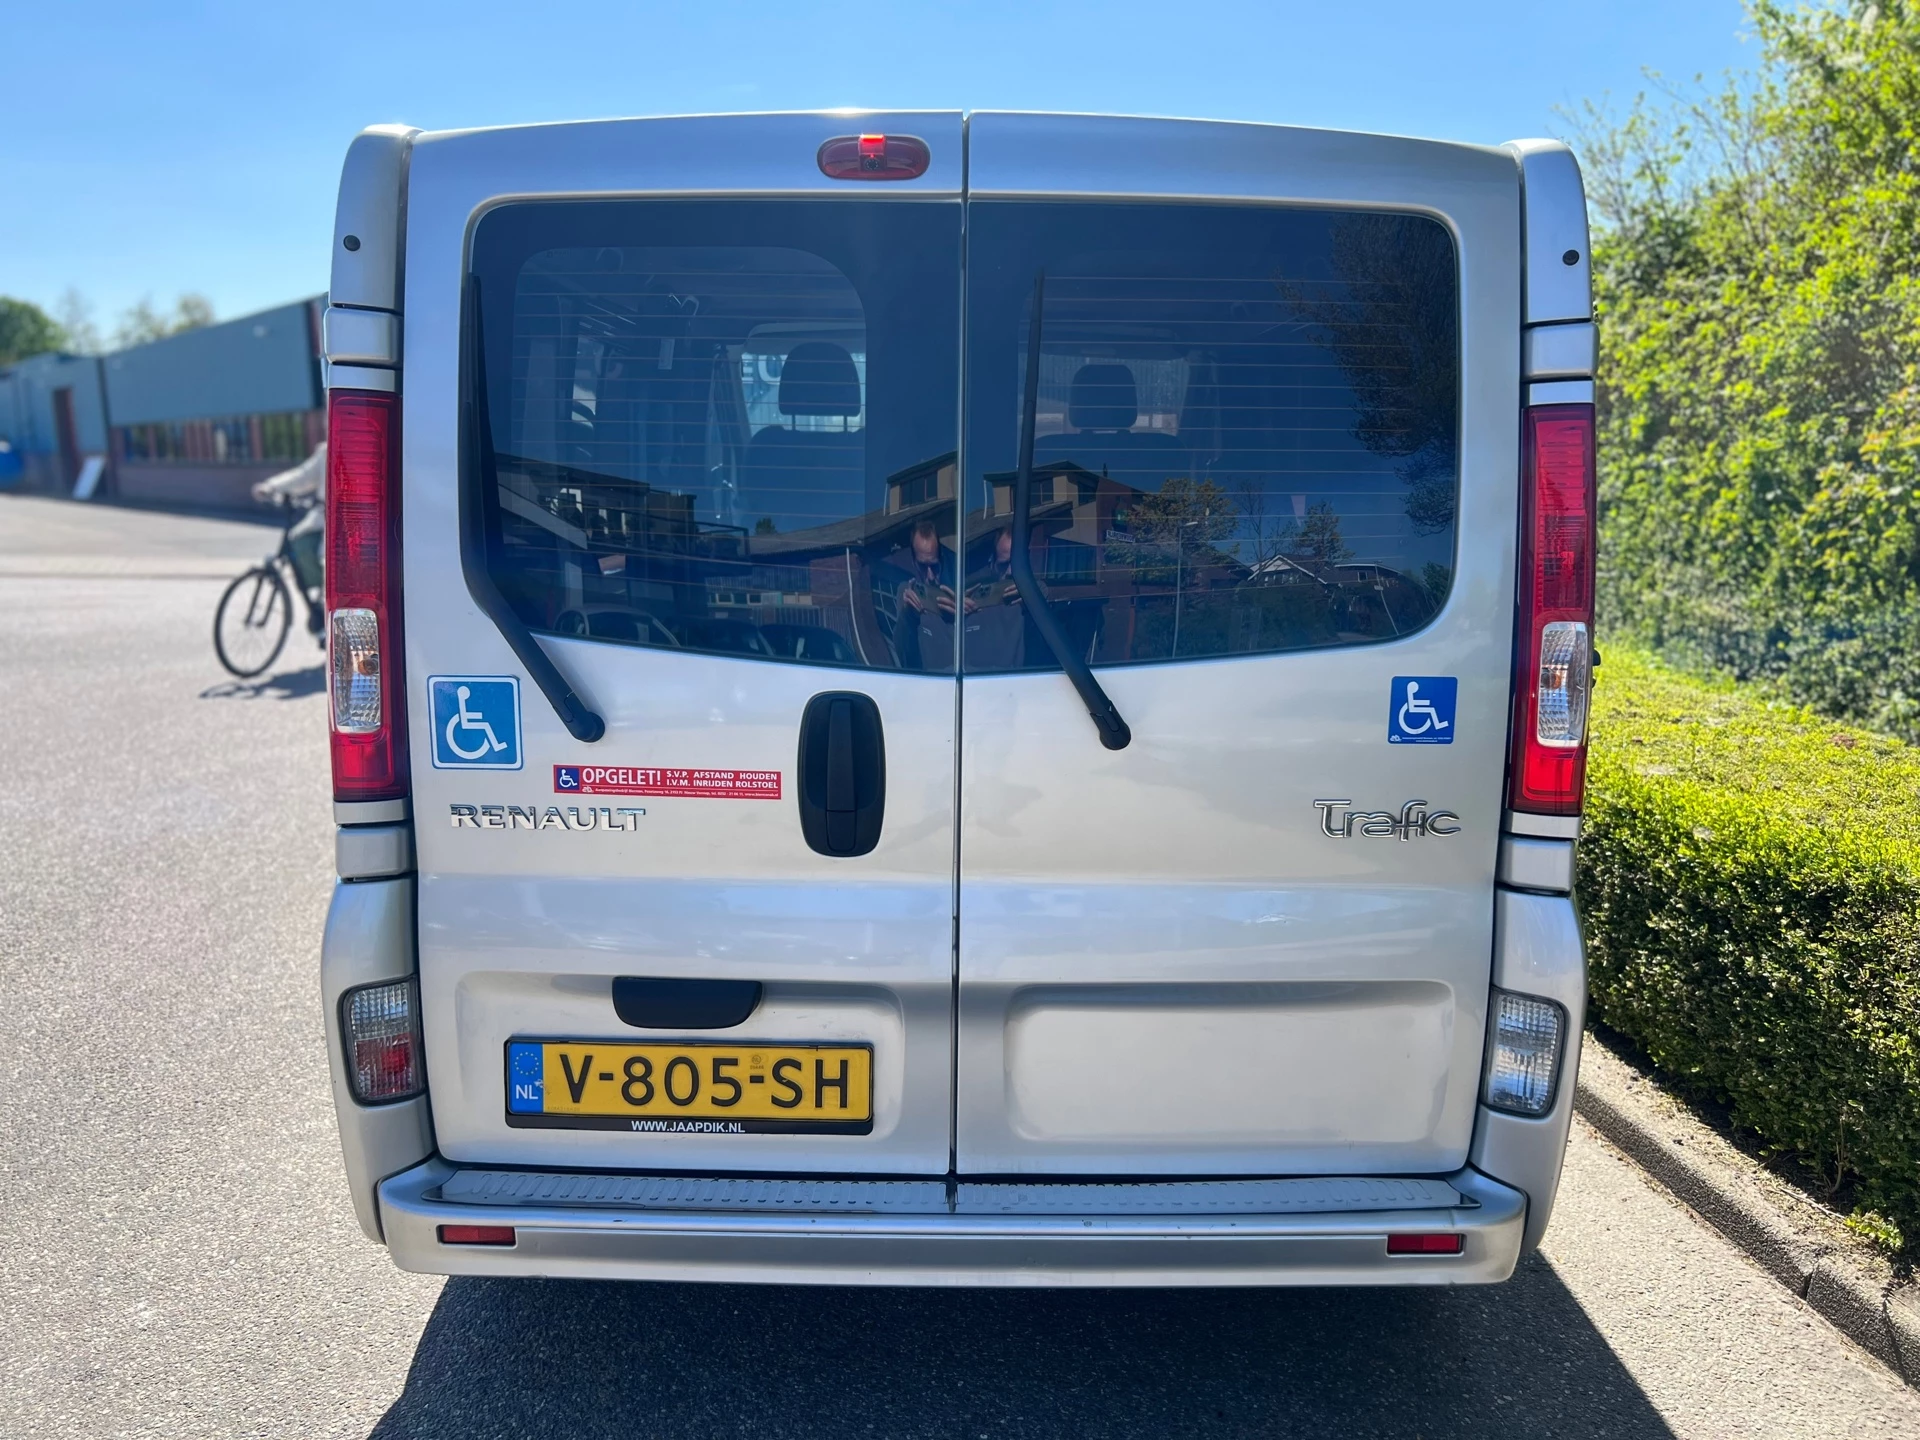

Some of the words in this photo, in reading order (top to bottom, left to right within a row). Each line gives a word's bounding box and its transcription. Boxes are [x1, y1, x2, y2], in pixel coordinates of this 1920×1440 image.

[582, 768, 661, 786] OPGELET!
[666, 770, 689, 778] S.V.P.
[693, 771, 734, 779] AFSTAND
[740, 772, 777, 780] HOUDEN
[693, 780, 733, 788] INRIJDEN
[736, 781, 778, 789] ROLSTOEL
[450, 803, 646, 832] RENAULT
[1313, 798, 1461, 842] Trafic
[559, 1053, 849, 1109] V-805-SH
[515, 1084, 539, 1101] NL
[631, 1119, 746, 1134] WWW.JAAPDIK.NL
